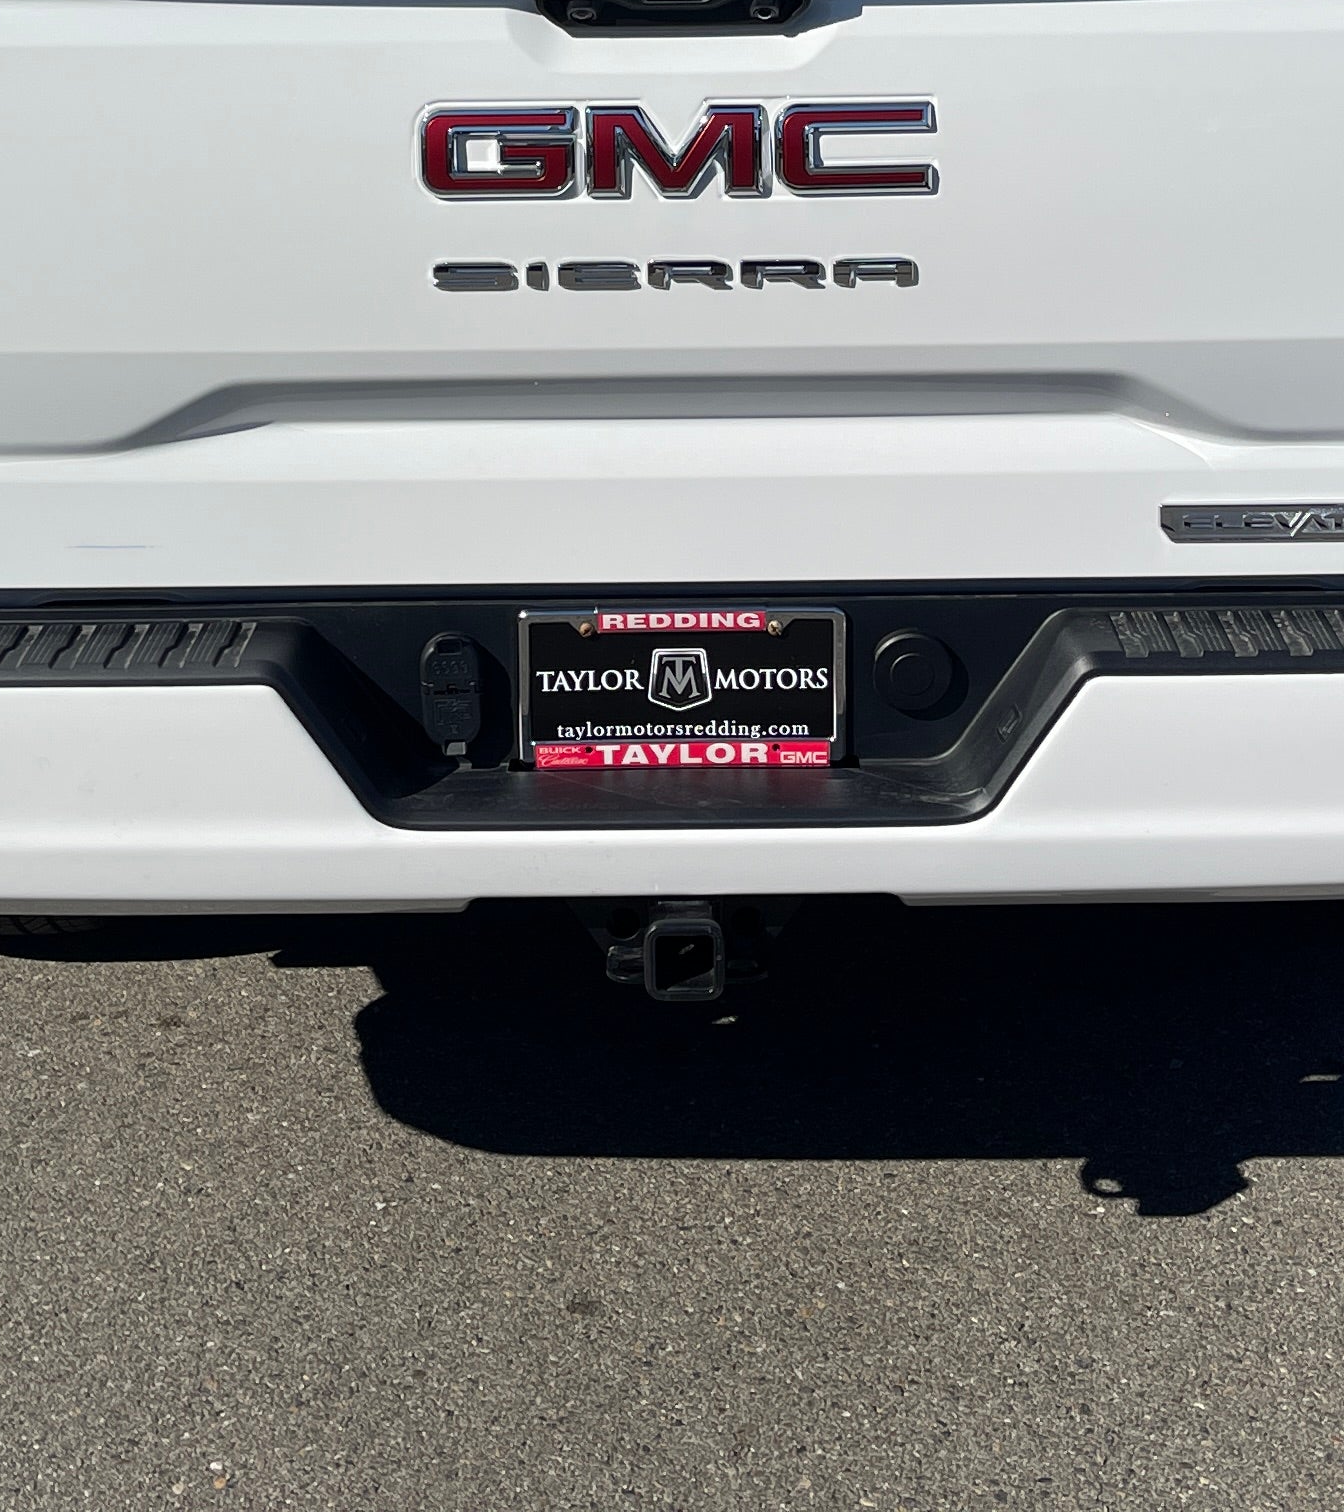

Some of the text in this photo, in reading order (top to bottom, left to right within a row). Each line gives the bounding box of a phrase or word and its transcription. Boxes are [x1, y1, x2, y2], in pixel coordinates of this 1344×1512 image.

[418, 98, 939, 200] GMC
[430, 257, 921, 292] SIERRA
[601, 611, 762, 630] REDDING
[535, 669, 645, 693] TAYLOR
[714, 667, 829, 692] MOTORS
[556, 720, 810, 740] taylormotorsredding.com
[539, 747, 582, 755] BUICK
[595, 743, 769, 765] TAYLOR
[779, 751, 828, 764] GMC
